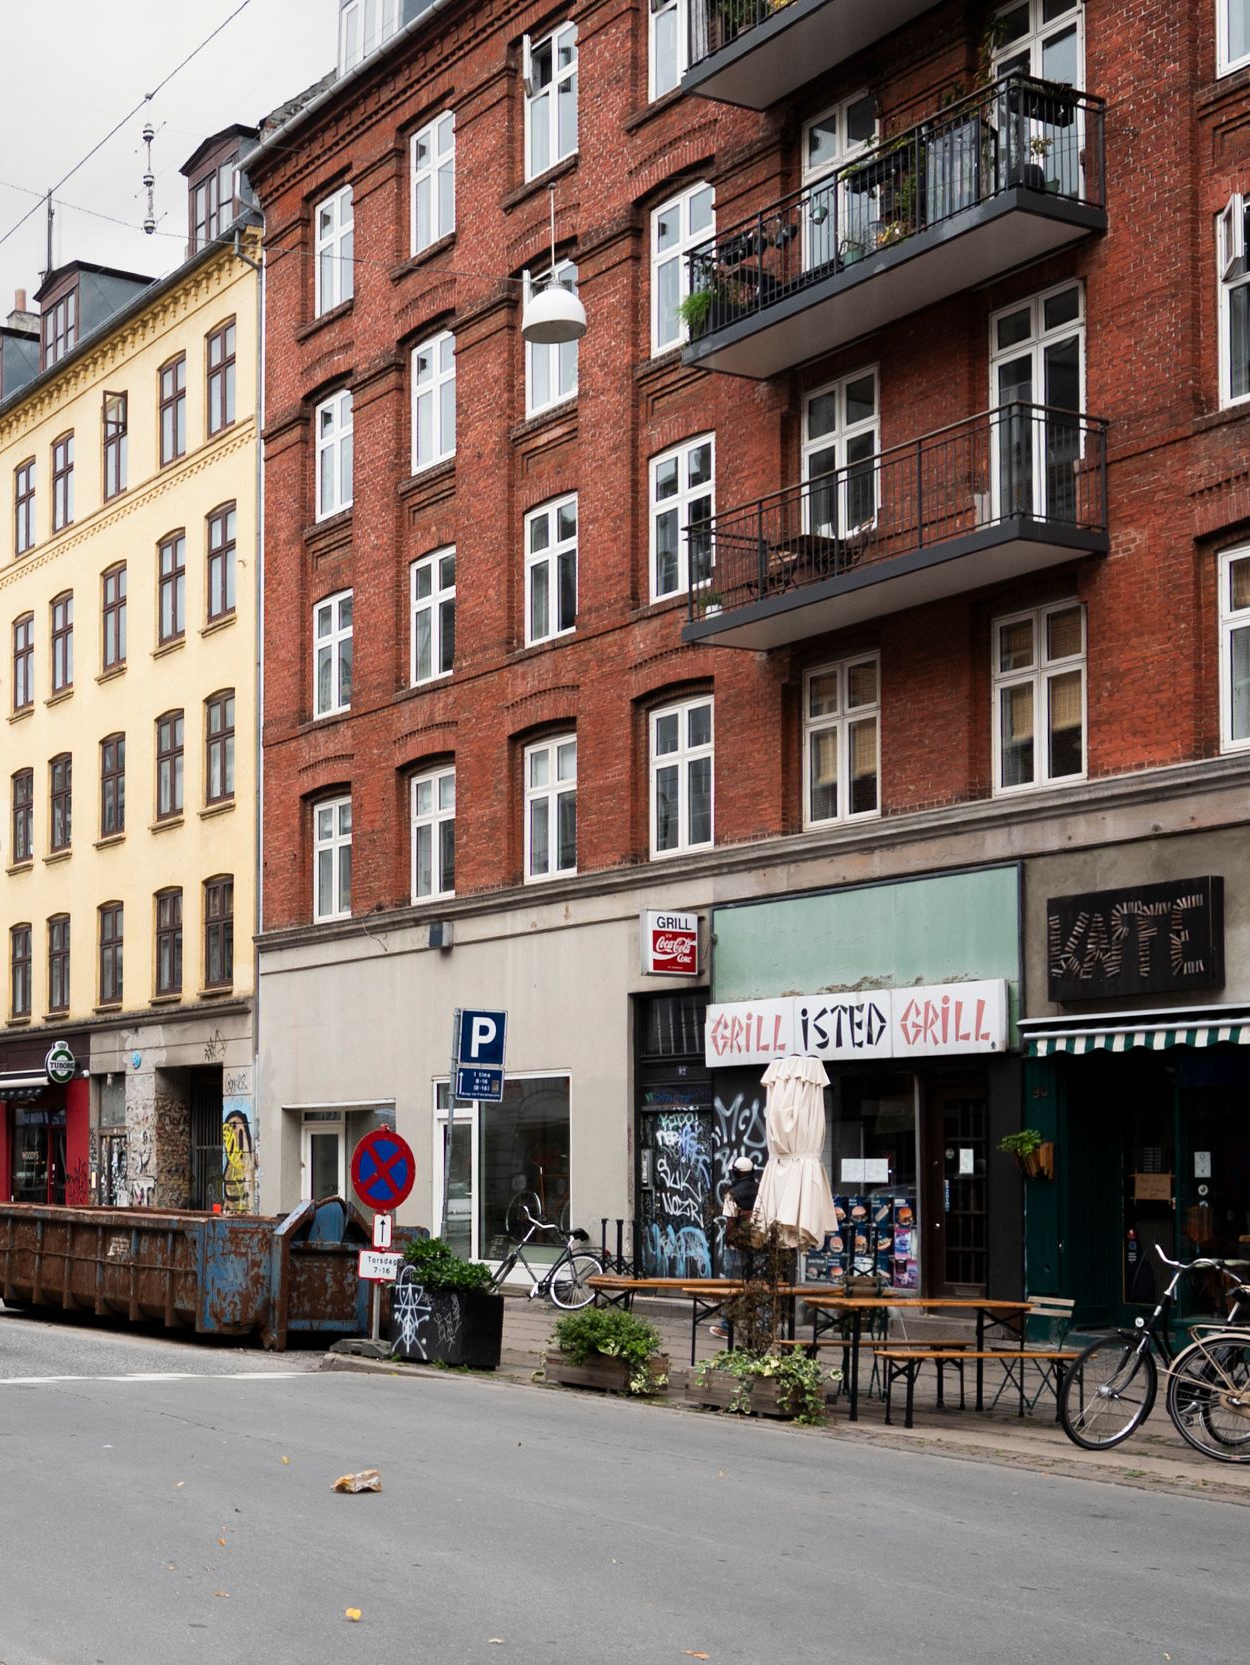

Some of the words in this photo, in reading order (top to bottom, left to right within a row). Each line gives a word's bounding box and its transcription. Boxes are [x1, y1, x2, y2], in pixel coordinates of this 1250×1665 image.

[657, 916, 692, 930] GRILL
[1049, 894, 1205, 979] KAFFE
[471, 1017, 496, 1058] P
[368, 1256, 397, 1266] Torsdag
